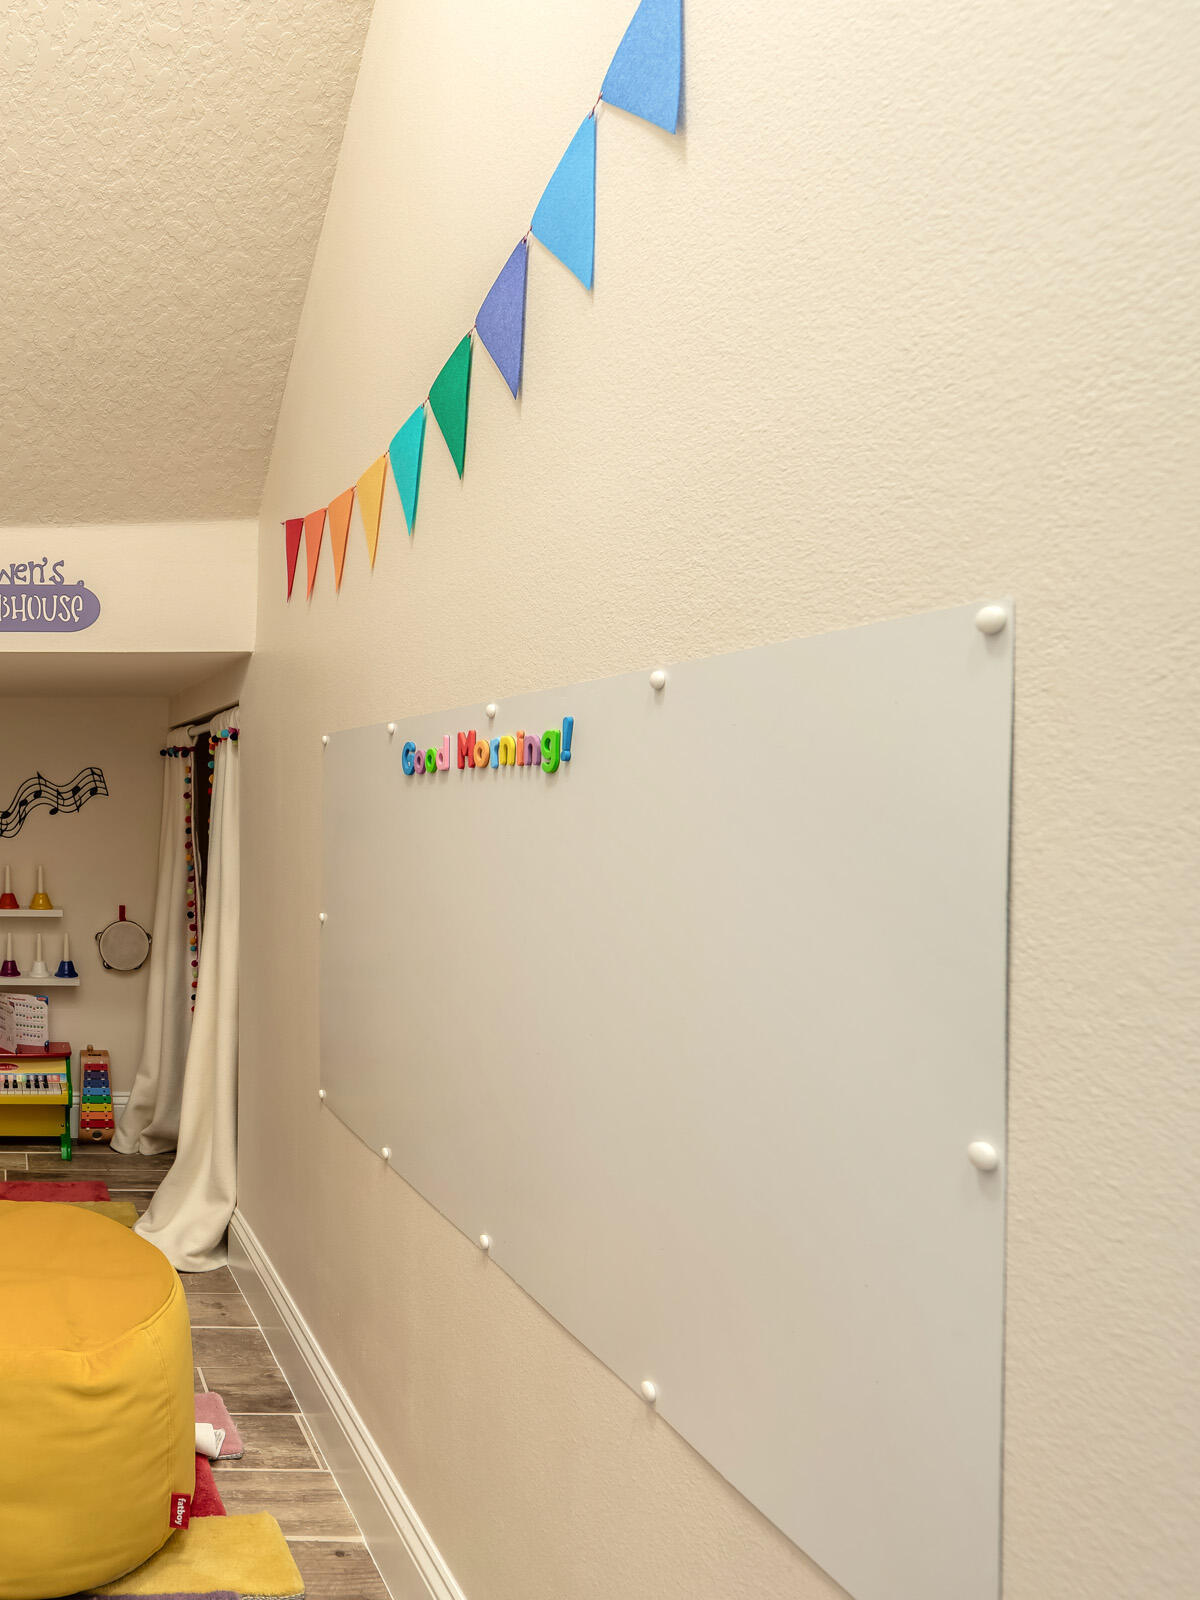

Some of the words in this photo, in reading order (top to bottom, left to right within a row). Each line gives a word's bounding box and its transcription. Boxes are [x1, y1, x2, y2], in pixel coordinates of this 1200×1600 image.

[402, 735, 450, 775] Good
[457, 716, 574, 773] Morning!
[174, 1498, 187, 1526] fatboy
